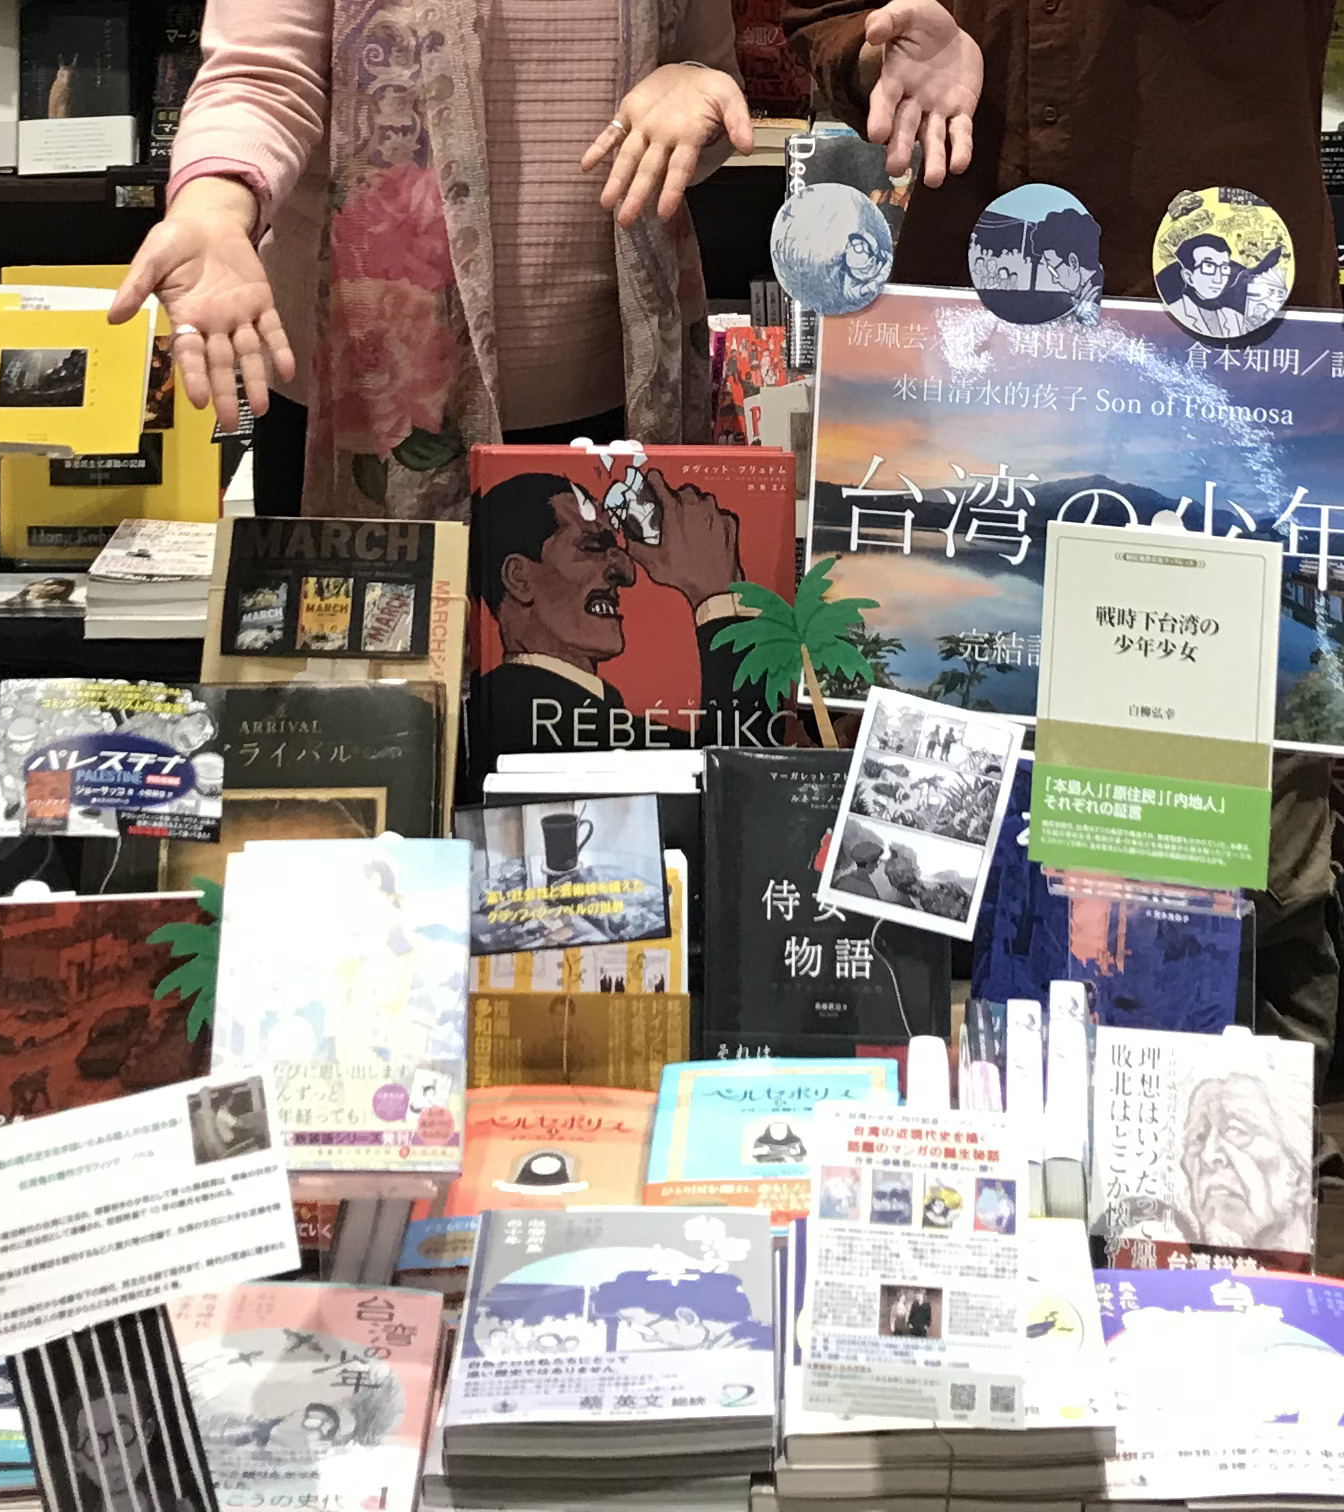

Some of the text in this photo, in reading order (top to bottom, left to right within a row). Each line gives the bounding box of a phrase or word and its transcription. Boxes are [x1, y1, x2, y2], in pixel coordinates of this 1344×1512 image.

[893, 373, 1295, 426] 來自清水的孩子 Son of Formosa
[239, 603, 285, 625] MARCH
[305, 599, 349, 616] MARCH
[368, 594, 408, 646] MARCH
[1094, 605, 1220, 638] 戦時下台湾の
[1111, 633, 1200, 664] 少年少女
[237, 719, 322, 735] ARRIVAL
[27, 749, 187, 775] パレスチナ
[76, 769, 143, 784] PALESTINE
[1043, 794, 1143, 822] それぞれの証言
[784, 935, 876, 981] 物語
